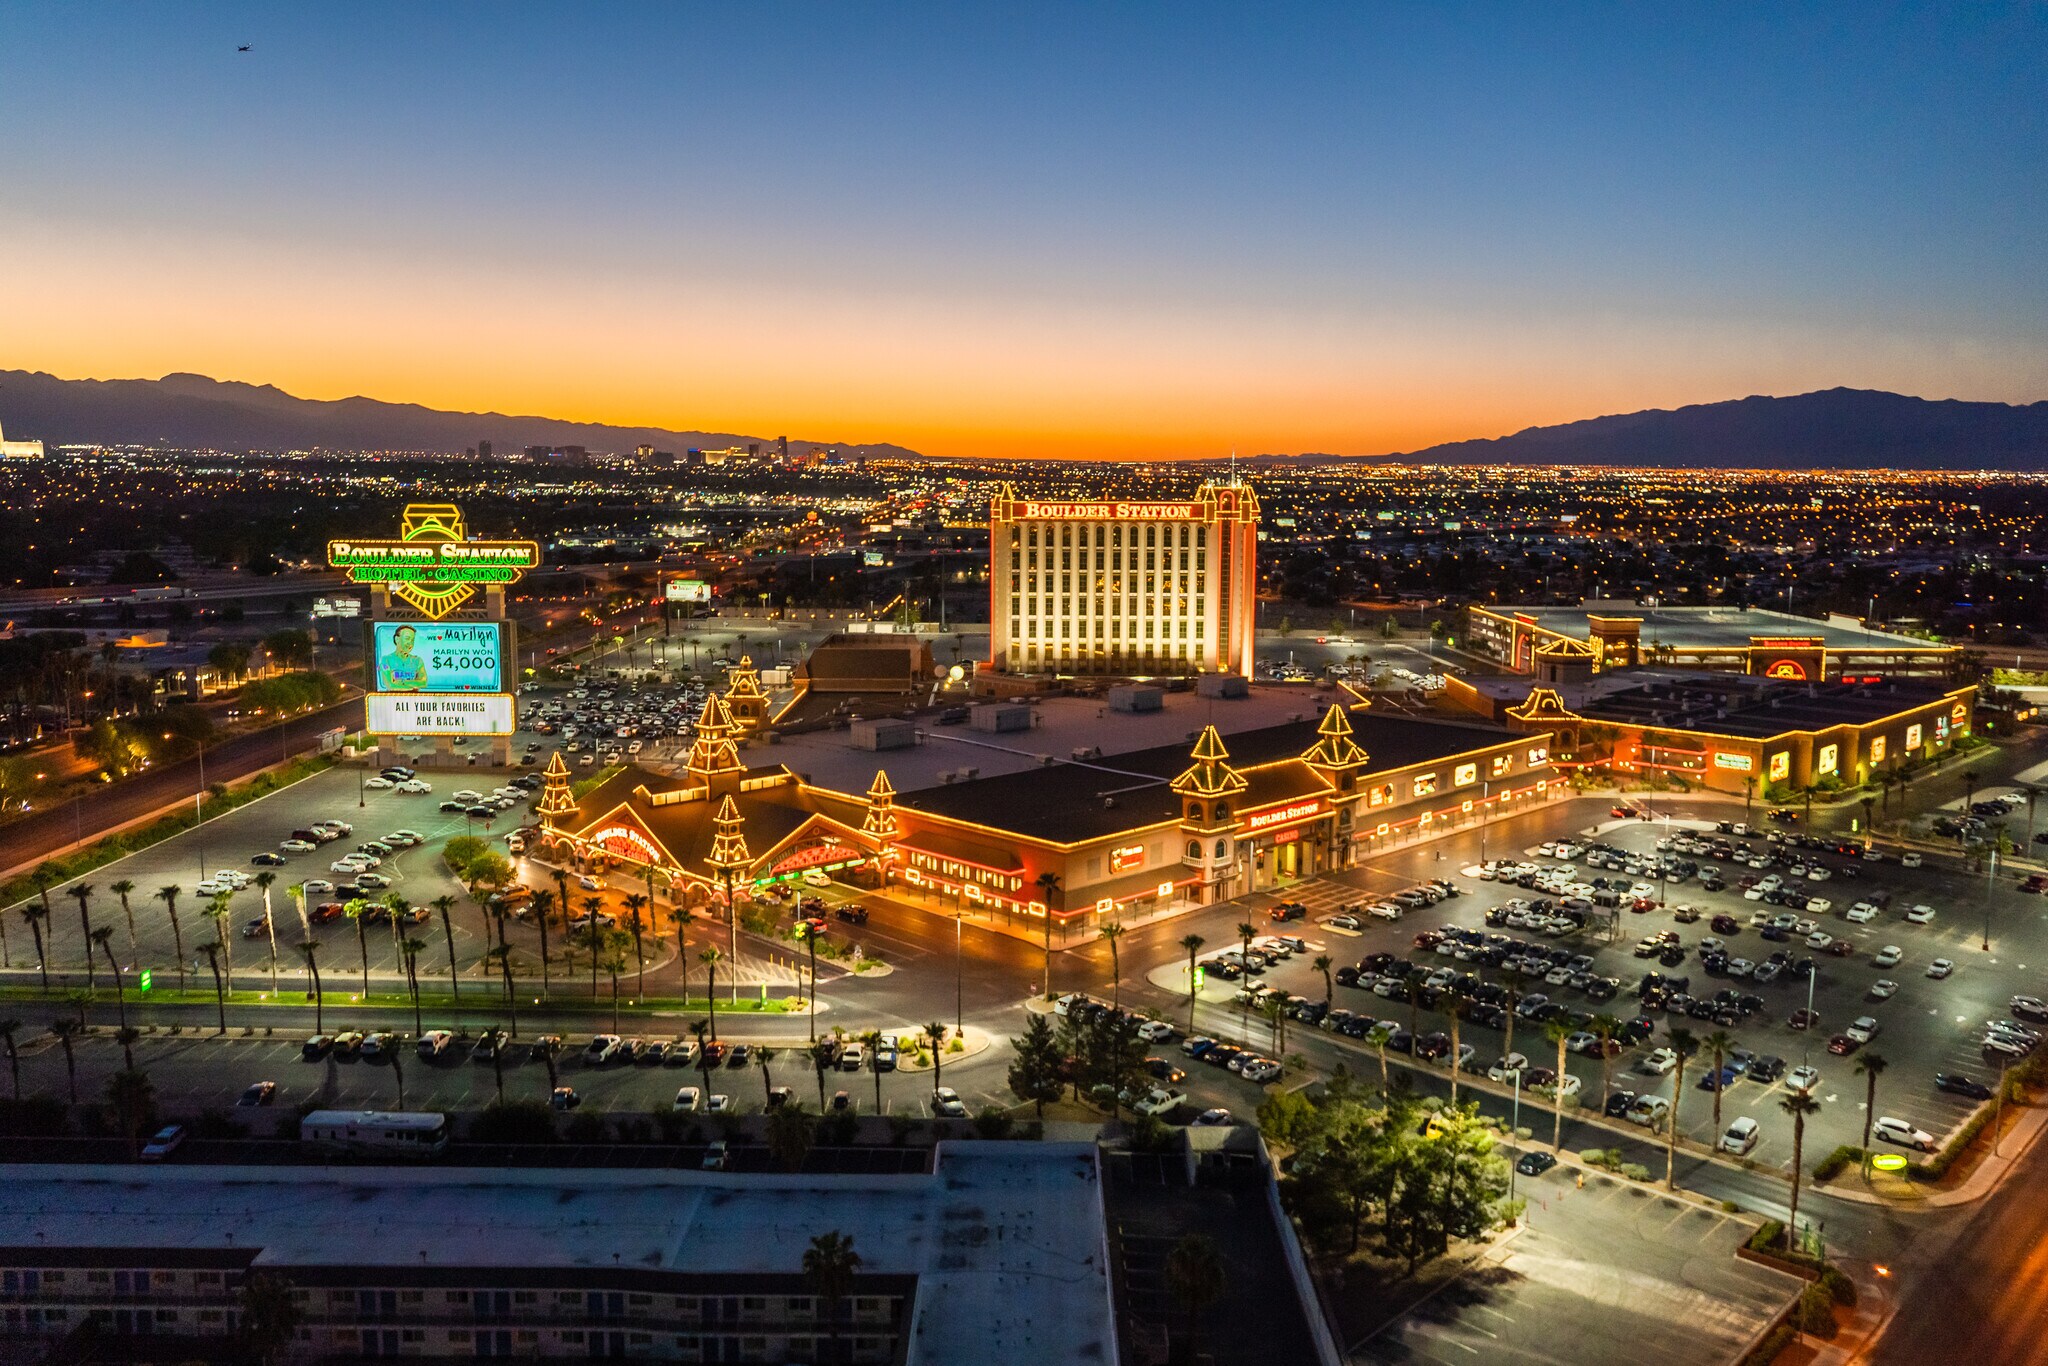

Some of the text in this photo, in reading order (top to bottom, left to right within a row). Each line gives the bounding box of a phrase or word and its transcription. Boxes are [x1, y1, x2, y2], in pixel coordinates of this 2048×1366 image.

[1025, 502, 1192, 518] BOULDER STATION
[332, 543, 531, 565] BOULDER STATION
[354, 567, 513, 581] HOTEL CASINO
[444, 626, 494, 647] Marilyn
[432, 656, 495, 671] $4,000
[395, 702, 485, 712] ALL YOUR FAVORITES
[416, 716, 465, 727] ARE BACK!
